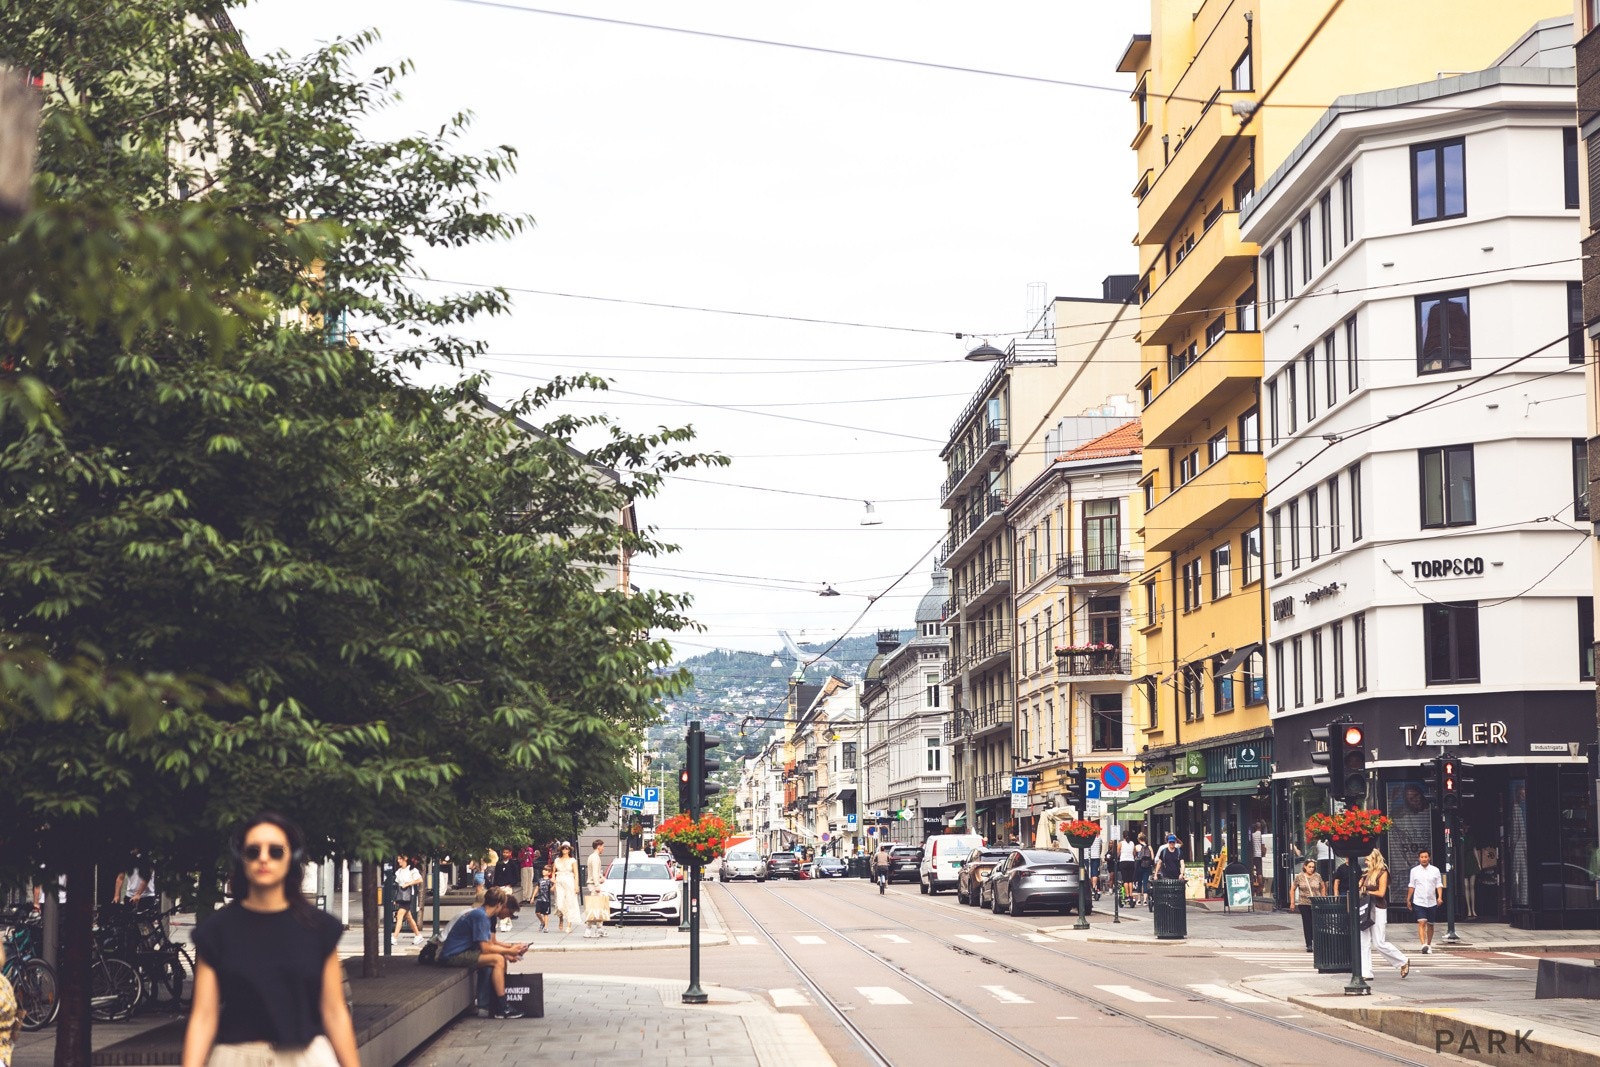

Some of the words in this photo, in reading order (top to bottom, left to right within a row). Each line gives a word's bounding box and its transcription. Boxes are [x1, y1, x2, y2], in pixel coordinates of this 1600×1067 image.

[1411, 557, 1484, 578] TORP&CO
[1399, 720, 1508, 746] TALER
[1015, 779, 1025, 792] P
[1086, 781, 1096, 797] P
[647, 789, 656, 801] P
[624, 797, 642, 807] Taxi
[849, 815, 855, 823] P
[504, 986, 530, 995] ONIKER
